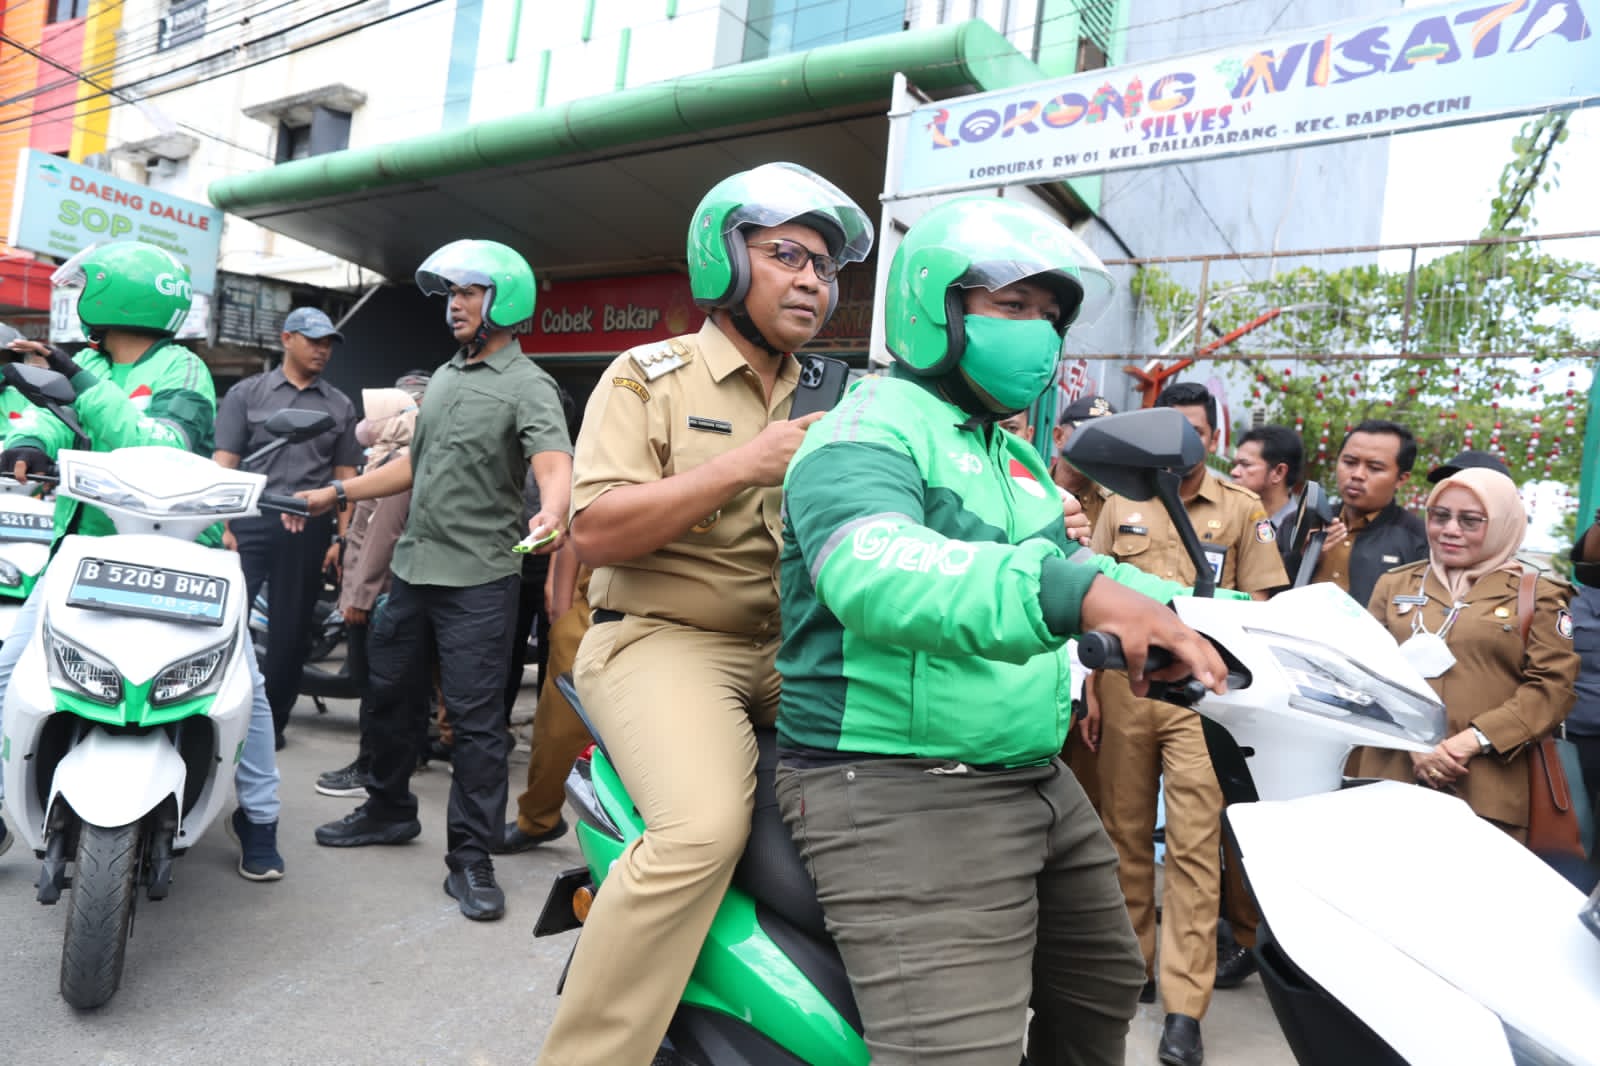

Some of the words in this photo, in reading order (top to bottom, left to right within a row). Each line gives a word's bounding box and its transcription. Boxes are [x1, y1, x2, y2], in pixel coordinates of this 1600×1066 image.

[923, 72, 1196, 150] LORONG
[1217, 0, 1592, 99] WISATA
[1053, 154, 1078, 168] RW
[1083, 150, 1099, 164] 01
[1149, 124, 1277, 154] BALLAPARANG
[1346, 96, 1472, 127] RAPPOCINI
[58, 199, 133, 238] SOP
[69, 176, 143, 210] DAENG
[149, 201, 210, 231] DALLE
[541, 305, 593, 333] Cobek
[603, 304, 659, 331] Bakar
[1, 513, 34, 527] 5217
[84, 563, 99, 580] B
[108, 566, 166, 590] 5209
[175, 576, 218, 599] BWA
